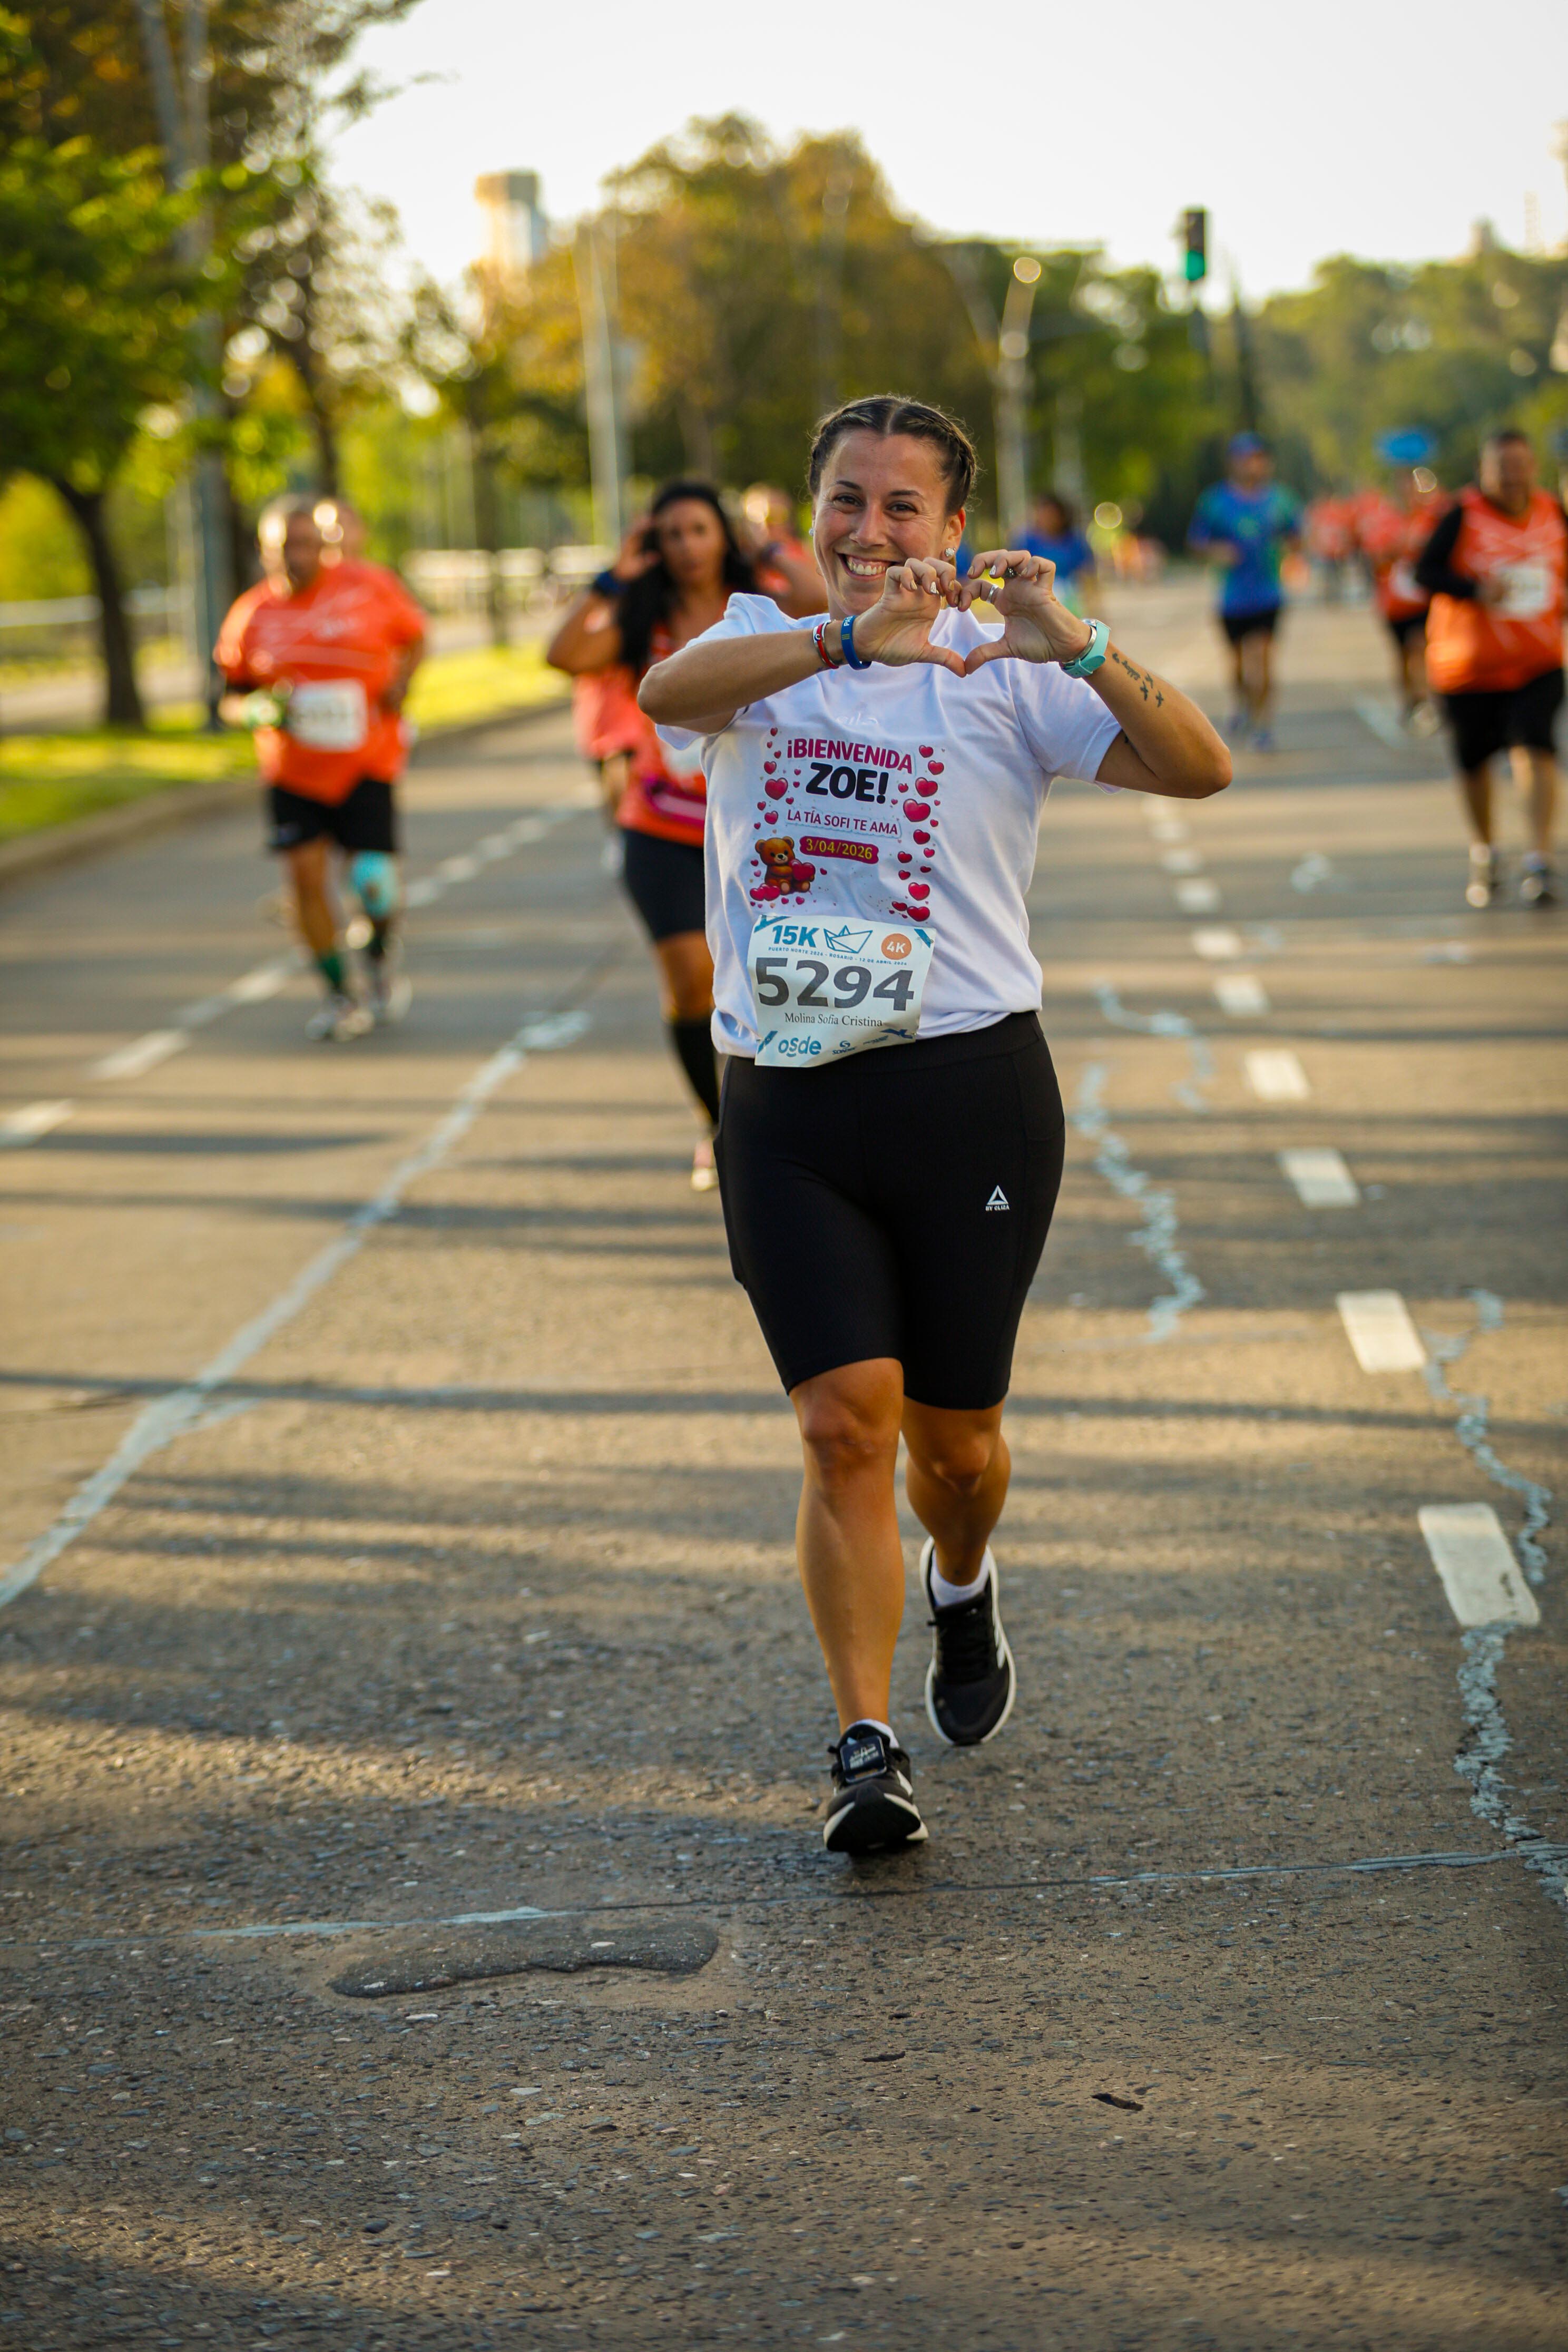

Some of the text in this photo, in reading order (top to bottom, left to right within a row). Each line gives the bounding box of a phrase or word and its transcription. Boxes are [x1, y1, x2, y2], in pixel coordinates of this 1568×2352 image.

[787, 738, 913, 774] ¡BIENVENIDA
[805, 762, 889, 804] ZOE!
[787, 809, 898, 835] LA TÍA SOFI TE AMA
[805, 838, 873, 860] 3/04/2026
[772, 925, 820, 948] 15K
[886, 940, 905, 954] 4K
[756, 957, 914, 1011] 5294
[785, 1012, 883, 1027] Molina Sofia Cristina
[778, 1035, 821, 1055] osde
